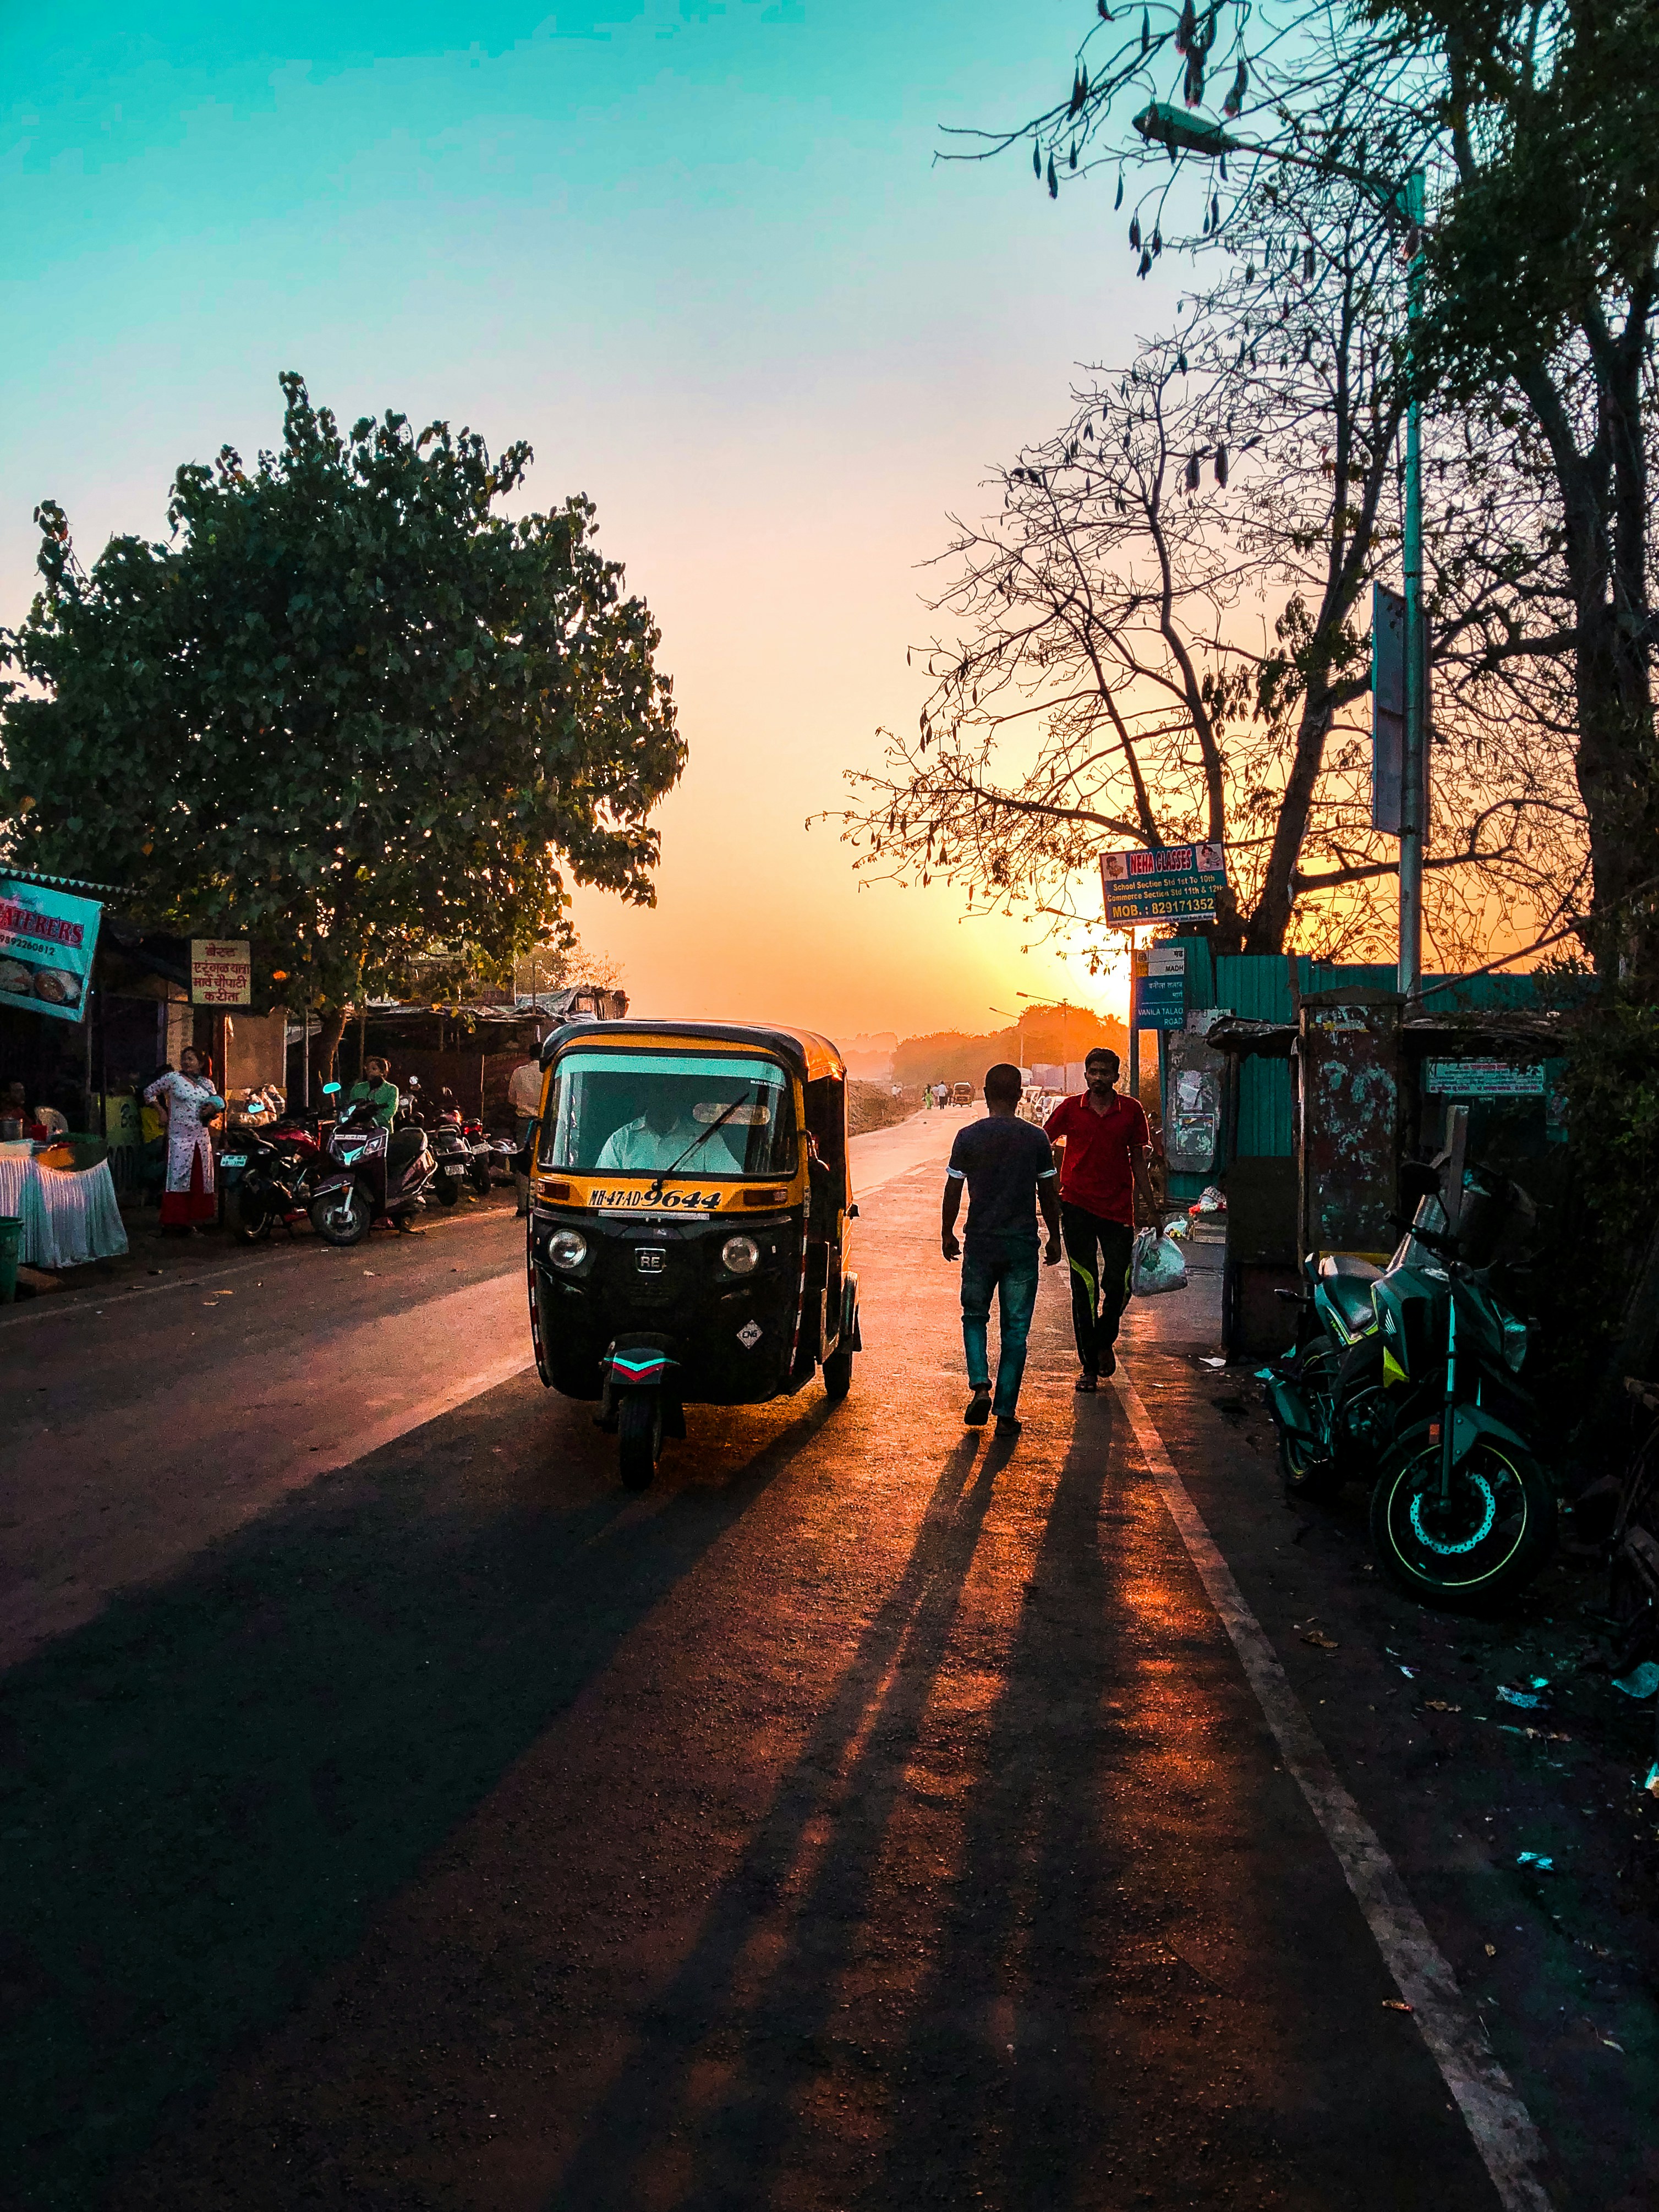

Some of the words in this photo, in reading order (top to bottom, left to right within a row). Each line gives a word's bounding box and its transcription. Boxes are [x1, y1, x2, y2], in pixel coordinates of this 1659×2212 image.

[1130, 852, 1154, 875] NEHA
[1156, 848, 1192, 873] CLASSES
[1113, 881, 1135, 891] School
[1137, 880, 1162, 889] Section
[1164, 878, 1175, 886] Std
[1177, 877, 1187, 885] 1st
[1189, 875, 1198, 884] To
[1200, 874, 1215, 883] 10th
[1107, 893, 1142, 902] Commerce
[1144, 891, 1169, 899] Section
[1171, 888, 1182, 896] Std
[1184, 886, 1200, 895] 11th
[1201, 885, 1206, 894] &
[1112, 904, 1142, 918] MOB.
[1152, 897, 1216, 915] 829171352
[0, 934, 55, 956] 9892260812
[640, 1256, 660, 1267] RE
[742, 1330, 757, 1338] CNG
